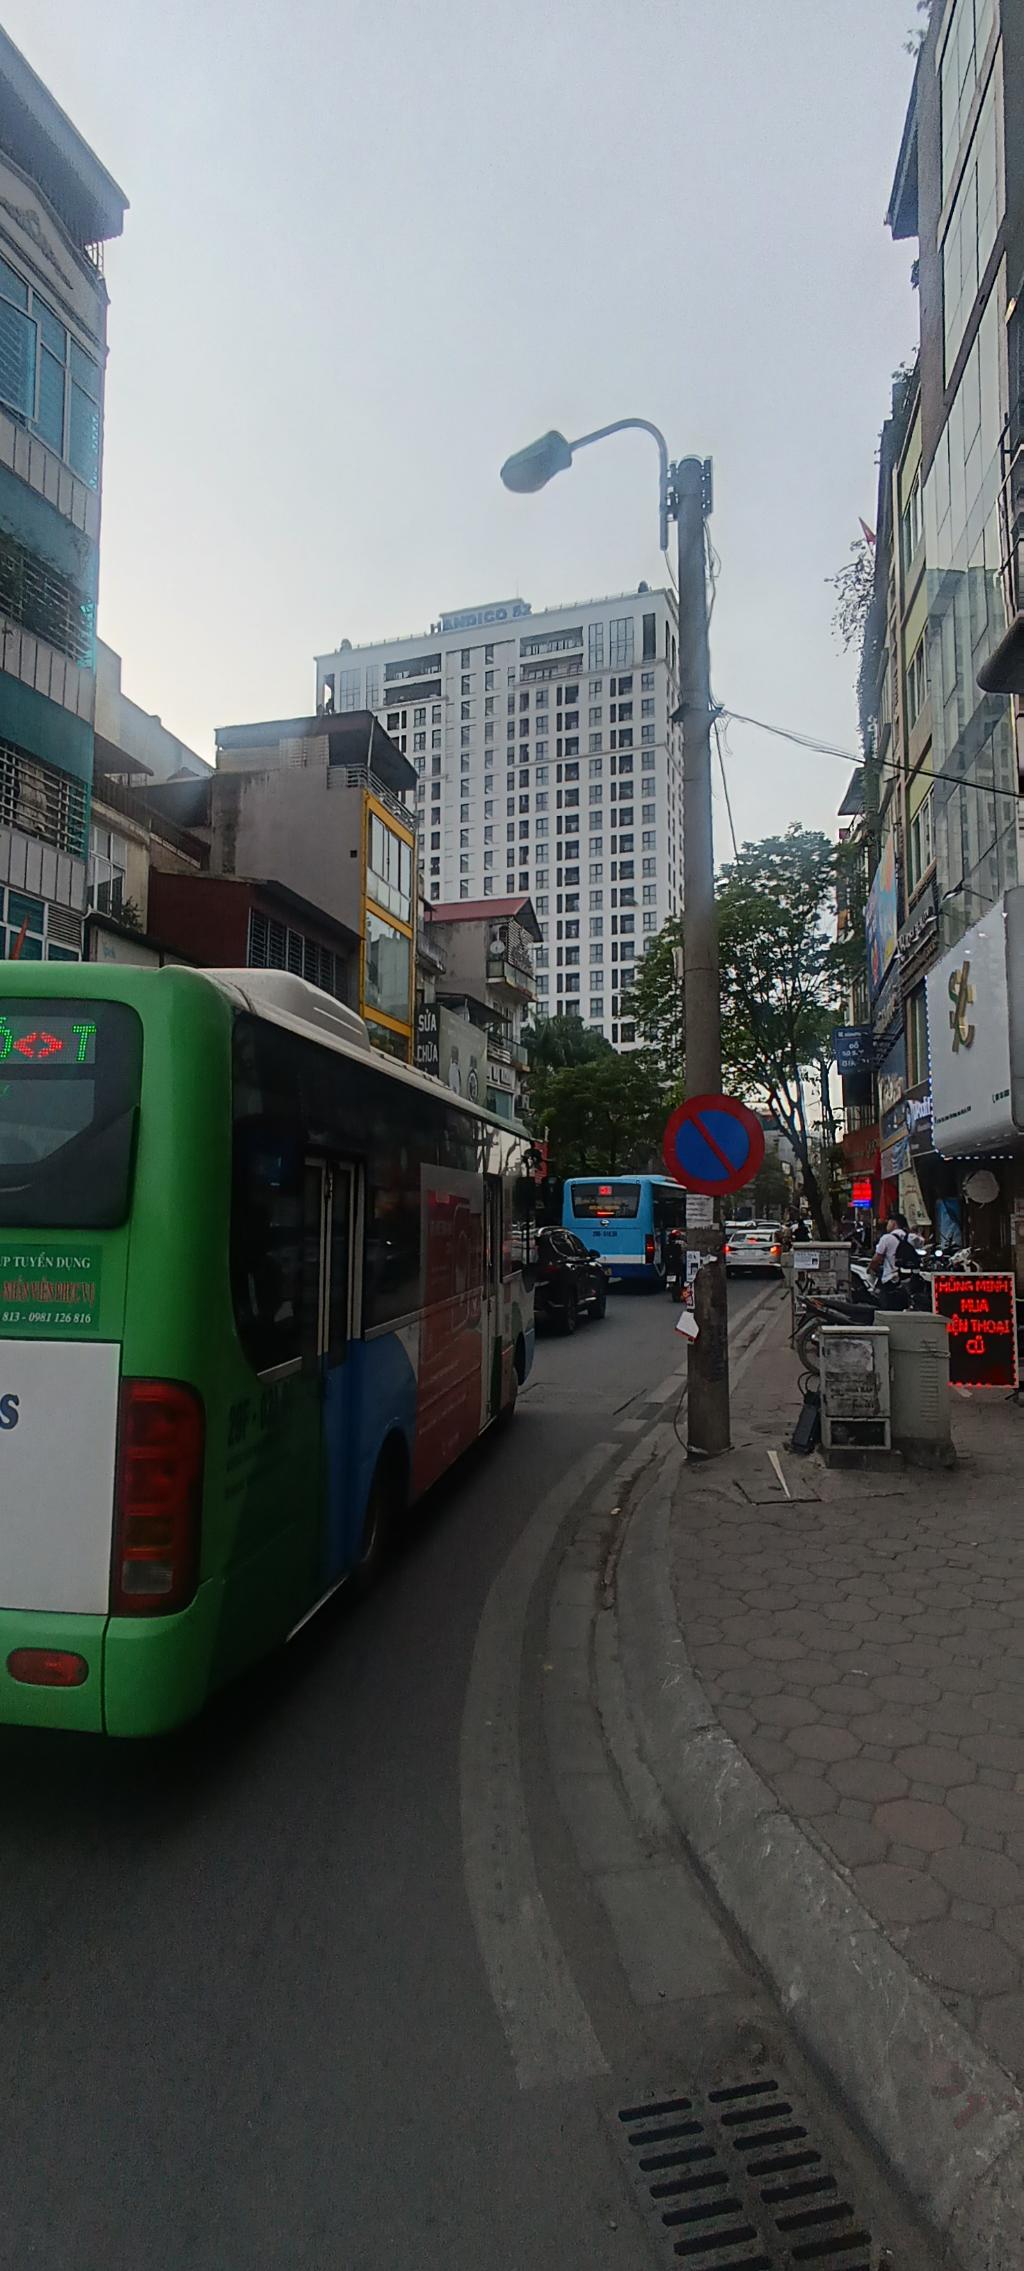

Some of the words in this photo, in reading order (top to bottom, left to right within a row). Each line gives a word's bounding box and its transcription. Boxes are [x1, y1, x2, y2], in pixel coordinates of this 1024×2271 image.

[430, 608, 508, 633] HANDICO
[418, 1009, 437, 1032] SỬA
[416, 1041, 438, 1062] CHỮA
[13, 1251, 53, 1268] TUYỂN
[56, 1257, 91, 1271] DỤNG
[961, 1298, 989, 1313] MUA
[2, 1311, 20, 1322] 813
[28, 1312, 52, 1322] 0981
[55, 1312, 71, 1323] 126
[73, 1313, 91, 1323] 816
[971, 1319, 1011, 1336] THOẠI
[965, 1335, 985, 1354] CŨ
